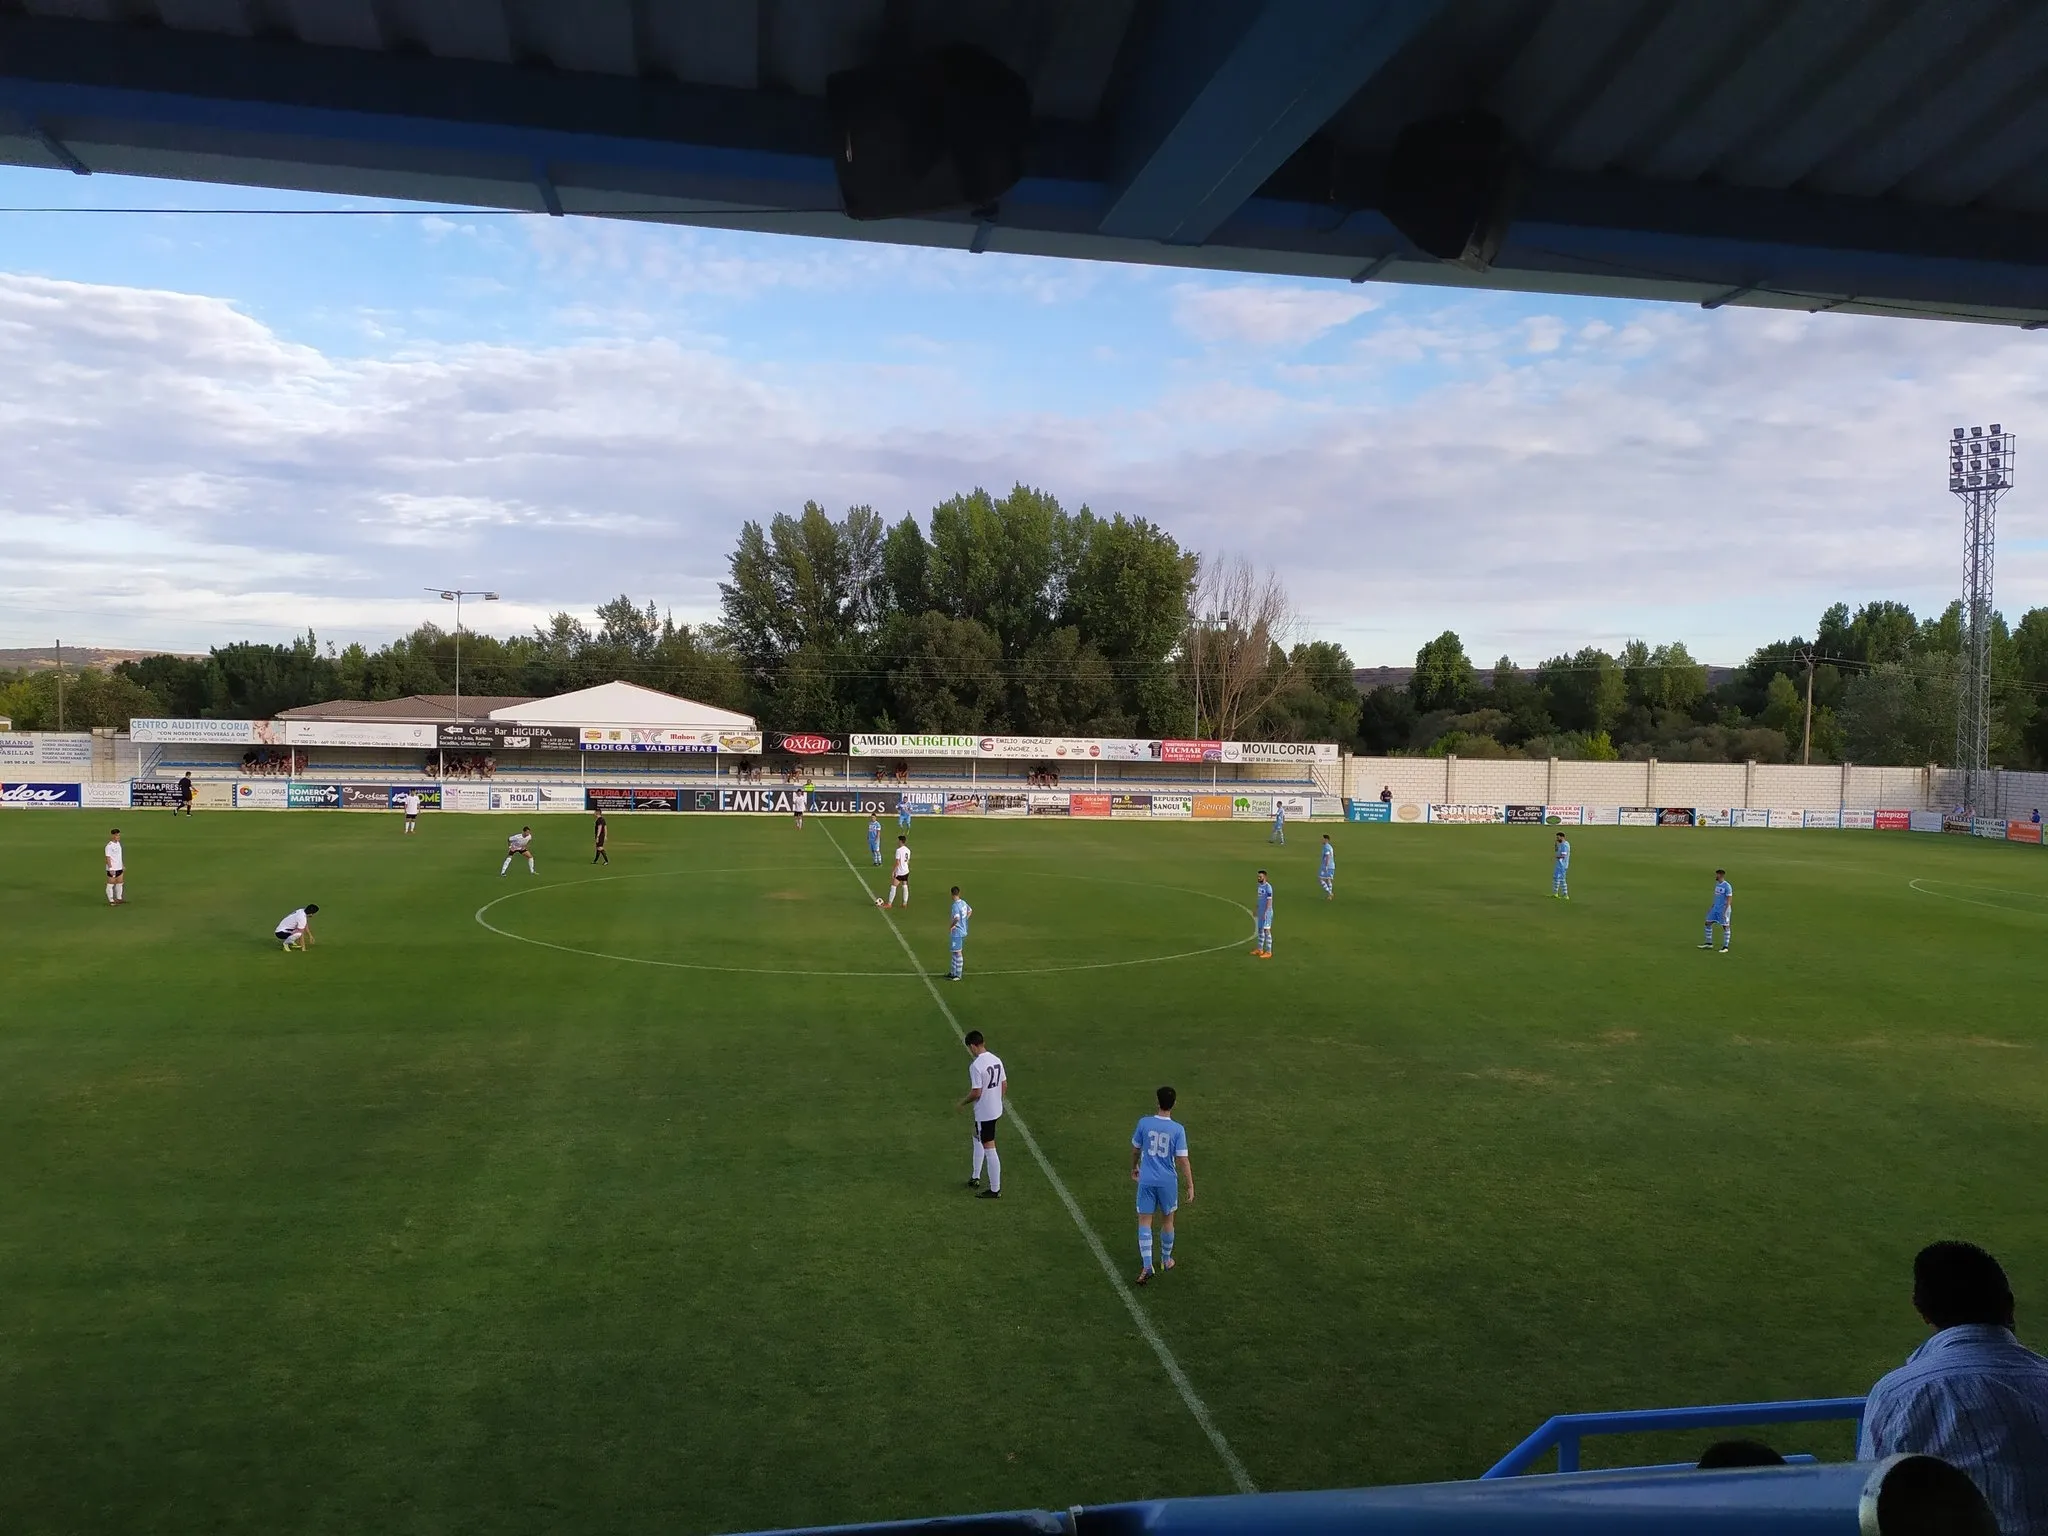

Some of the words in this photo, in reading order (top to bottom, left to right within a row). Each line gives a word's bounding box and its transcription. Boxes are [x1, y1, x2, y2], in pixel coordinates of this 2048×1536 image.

[131, 720, 169, 729] CENTRO
[171, 721, 218, 731] AUDITIVO
[220, 722, 250, 731] CORIA
[468, 727, 487, 736] Café
[494, 728, 507, 736] Bar
[512, 727, 553, 737] HIGUERA
[851, 735, 898, 746] CAMBIO
[901, 735, 974, 747] ENERGETICO
[1021, 737, 1053, 745] GONZÁLEZ
[585, 743, 637, 751] BODEGAS
[644, 744, 713, 753] VALDEPEÑAS
[1164, 746, 1202, 754] VICMAR
[1241, 743, 1317, 756] MOVILCORIA
[132, 783, 157, 791] DUCHA
[289, 788, 327, 796] ROMERO
[588, 789, 620, 797] CAURIA
[290, 795, 325, 803] MARTIN
[509, 794, 534, 802] ROLO
[809, 800, 886, 813] AZULEJOS
[1507, 809, 1517, 817] El
[1516, 809, 1544, 818] Casero
[1876, 811, 1909, 820] telepizza
[987, 1063, 1001, 1089] 27
[1147, 1130, 1171, 1158] 39
